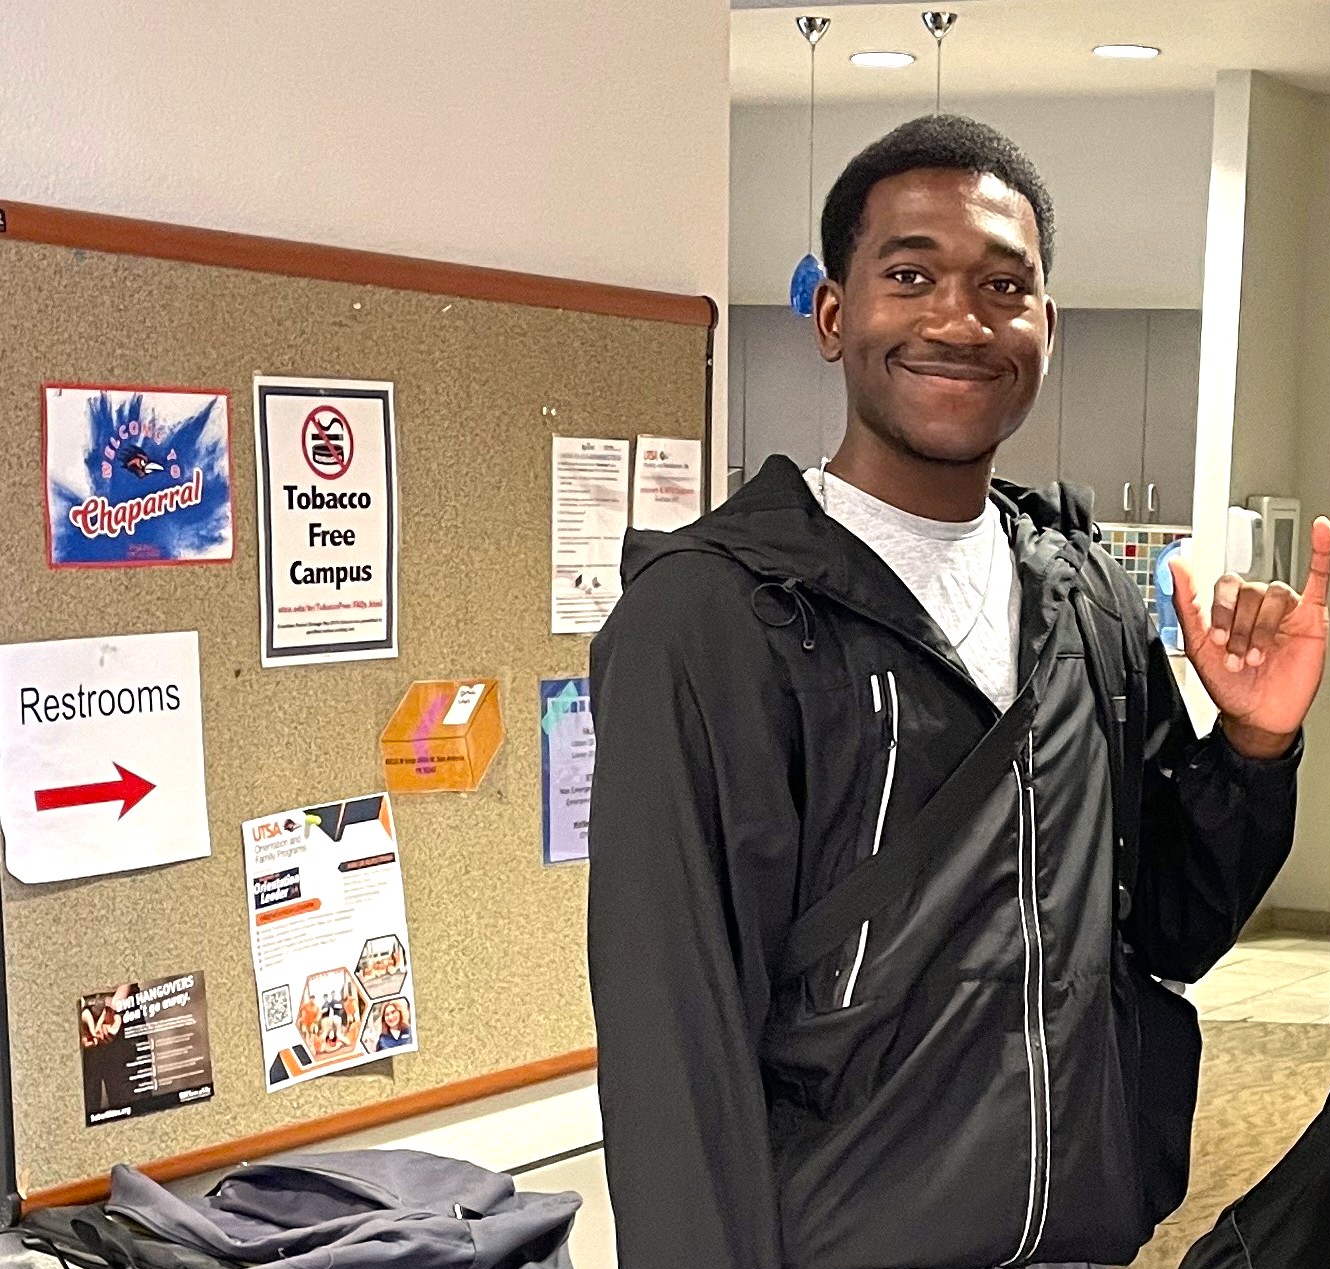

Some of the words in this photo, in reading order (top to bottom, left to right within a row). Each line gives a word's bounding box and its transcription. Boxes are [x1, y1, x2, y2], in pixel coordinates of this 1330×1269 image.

[70, 469, 202, 537] Chaparral
[283, 485, 372, 511] Tobacco
[309, 523, 356, 547] Free
[290, 561, 372, 590] Campus
[20, 683, 181, 725] Restrooms
[252, 822, 282, 842] UTSA
[135, 975, 194, 1006] HANGOVERS
[148, 1002, 161, 1018] go
